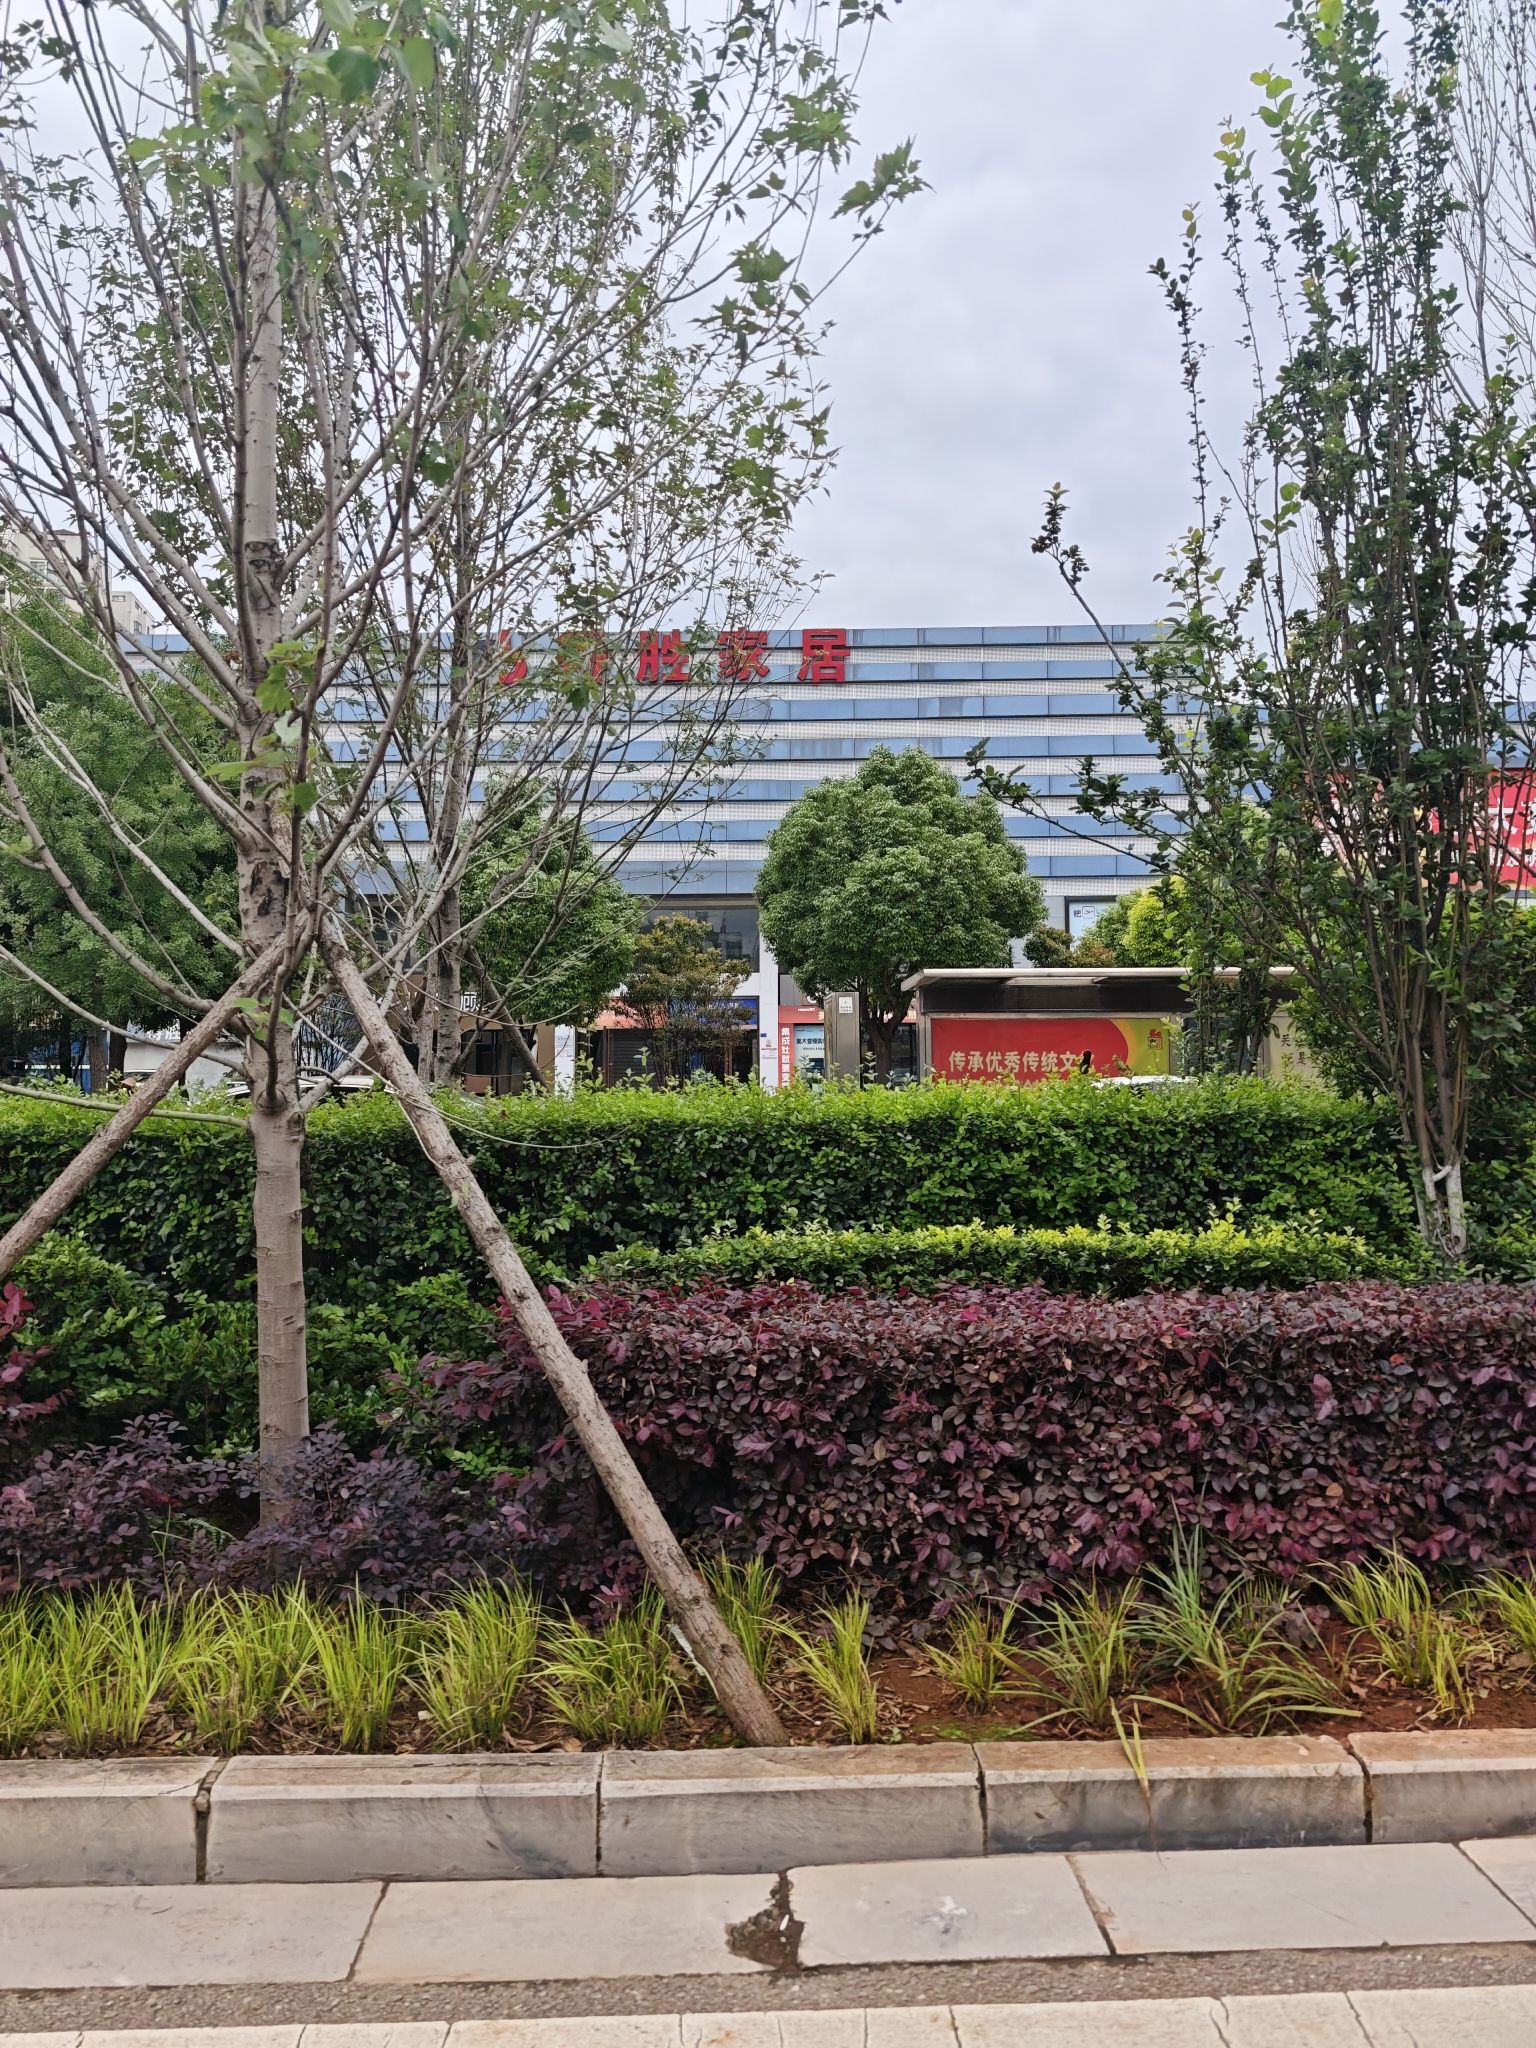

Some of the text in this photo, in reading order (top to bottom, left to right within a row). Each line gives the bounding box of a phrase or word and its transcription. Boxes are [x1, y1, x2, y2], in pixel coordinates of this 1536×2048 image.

[556, 628, 849, 683] 胜家居
[949, 1050, 1096, 1073] 传承优秀传统文
